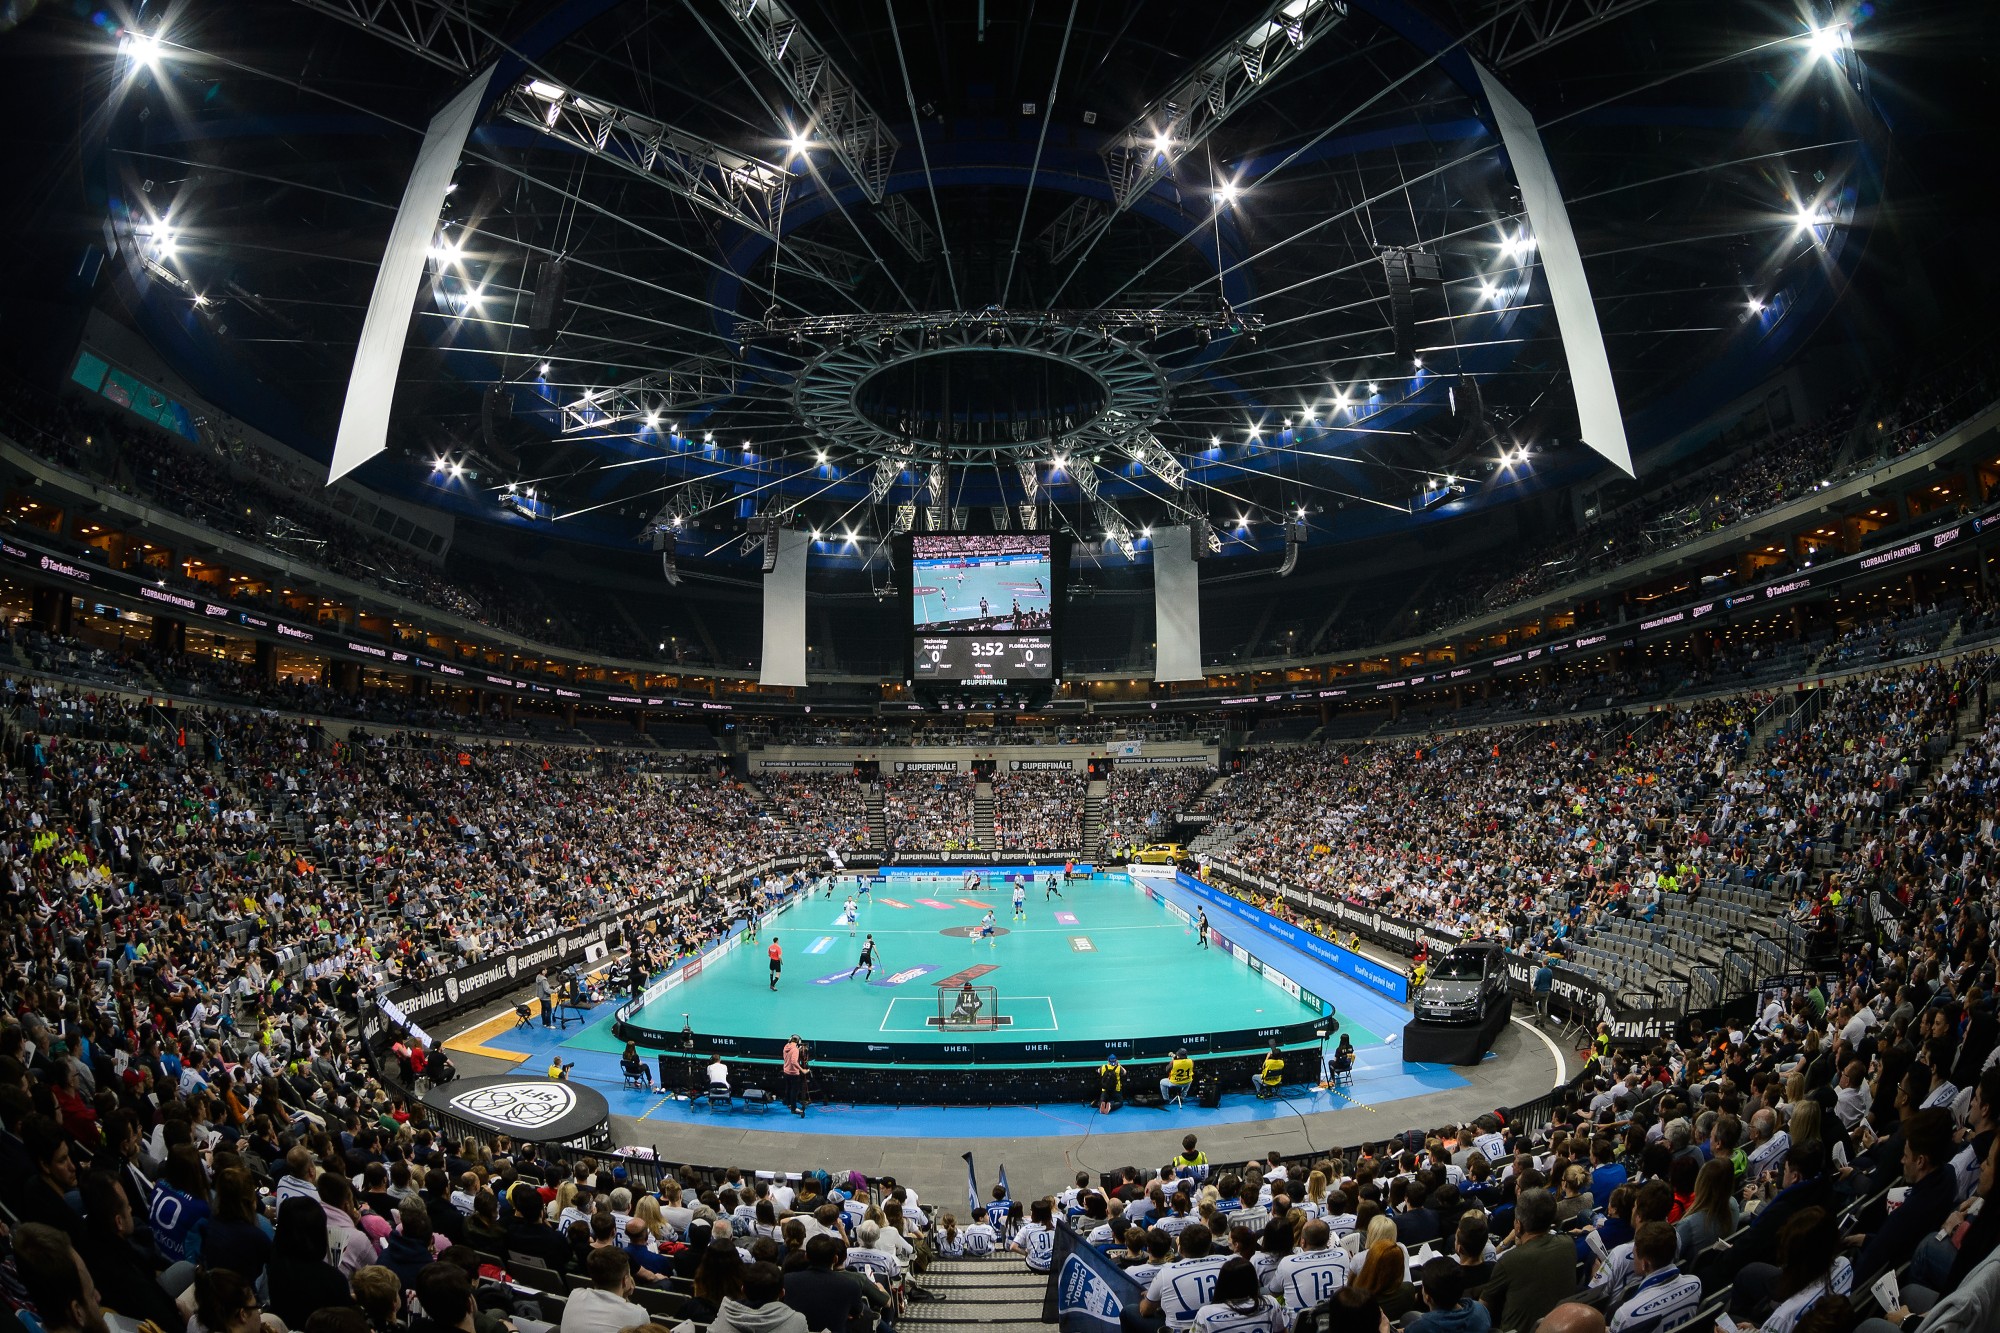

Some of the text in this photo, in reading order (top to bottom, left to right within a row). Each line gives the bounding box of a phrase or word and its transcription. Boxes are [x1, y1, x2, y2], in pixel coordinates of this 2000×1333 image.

[1860, 542, 1921, 569] FLORBALOVÍ PARTNEŘI
[141, 587, 172, 603] FLORBALOVÍ
[931, 650, 940, 663] 0
[971, 642, 1004, 656] 3:52
[1025, 649, 1034, 662] 0
[907, 761, 957, 771] SUPERFINÁLE
[1022, 761, 1072, 770] SUPERFINÁLE
[901, 852, 940, 860] SUPERFINÁLE
[951, 852, 991, 860] SUPERFINÁLE
[1002, 852, 1042, 860] SUPERFINÁLE
[1344, 907, 1373, 926] SUPERFINÁLE
[1380, 920, 1415, 941] SUPERFINÁLE
[518, 944, 558, 970] SUPERFINÁLE
[459, 962, 508, 994] SUPERFINÁLE
[1355, 964, 1369, 978] Vsaďte
[1302, 990, 1321, 1009] UHER
[1176, 1067, 1191, 1079] 21
[1491, 1142, 1501, 1156] 91
[150, 1187, 182, 1230] 10
[993, 1209, 1004, 1224] 77
[973, 1235, 983, 1250] 10
[1038, 1232, 1051, 1250] 91
[1311, 1270, 1335, 1300] 12
[1642, 1284, 1697, 1312] FAT PIPE
[1216, 1312, 1237, 1320] FAT
